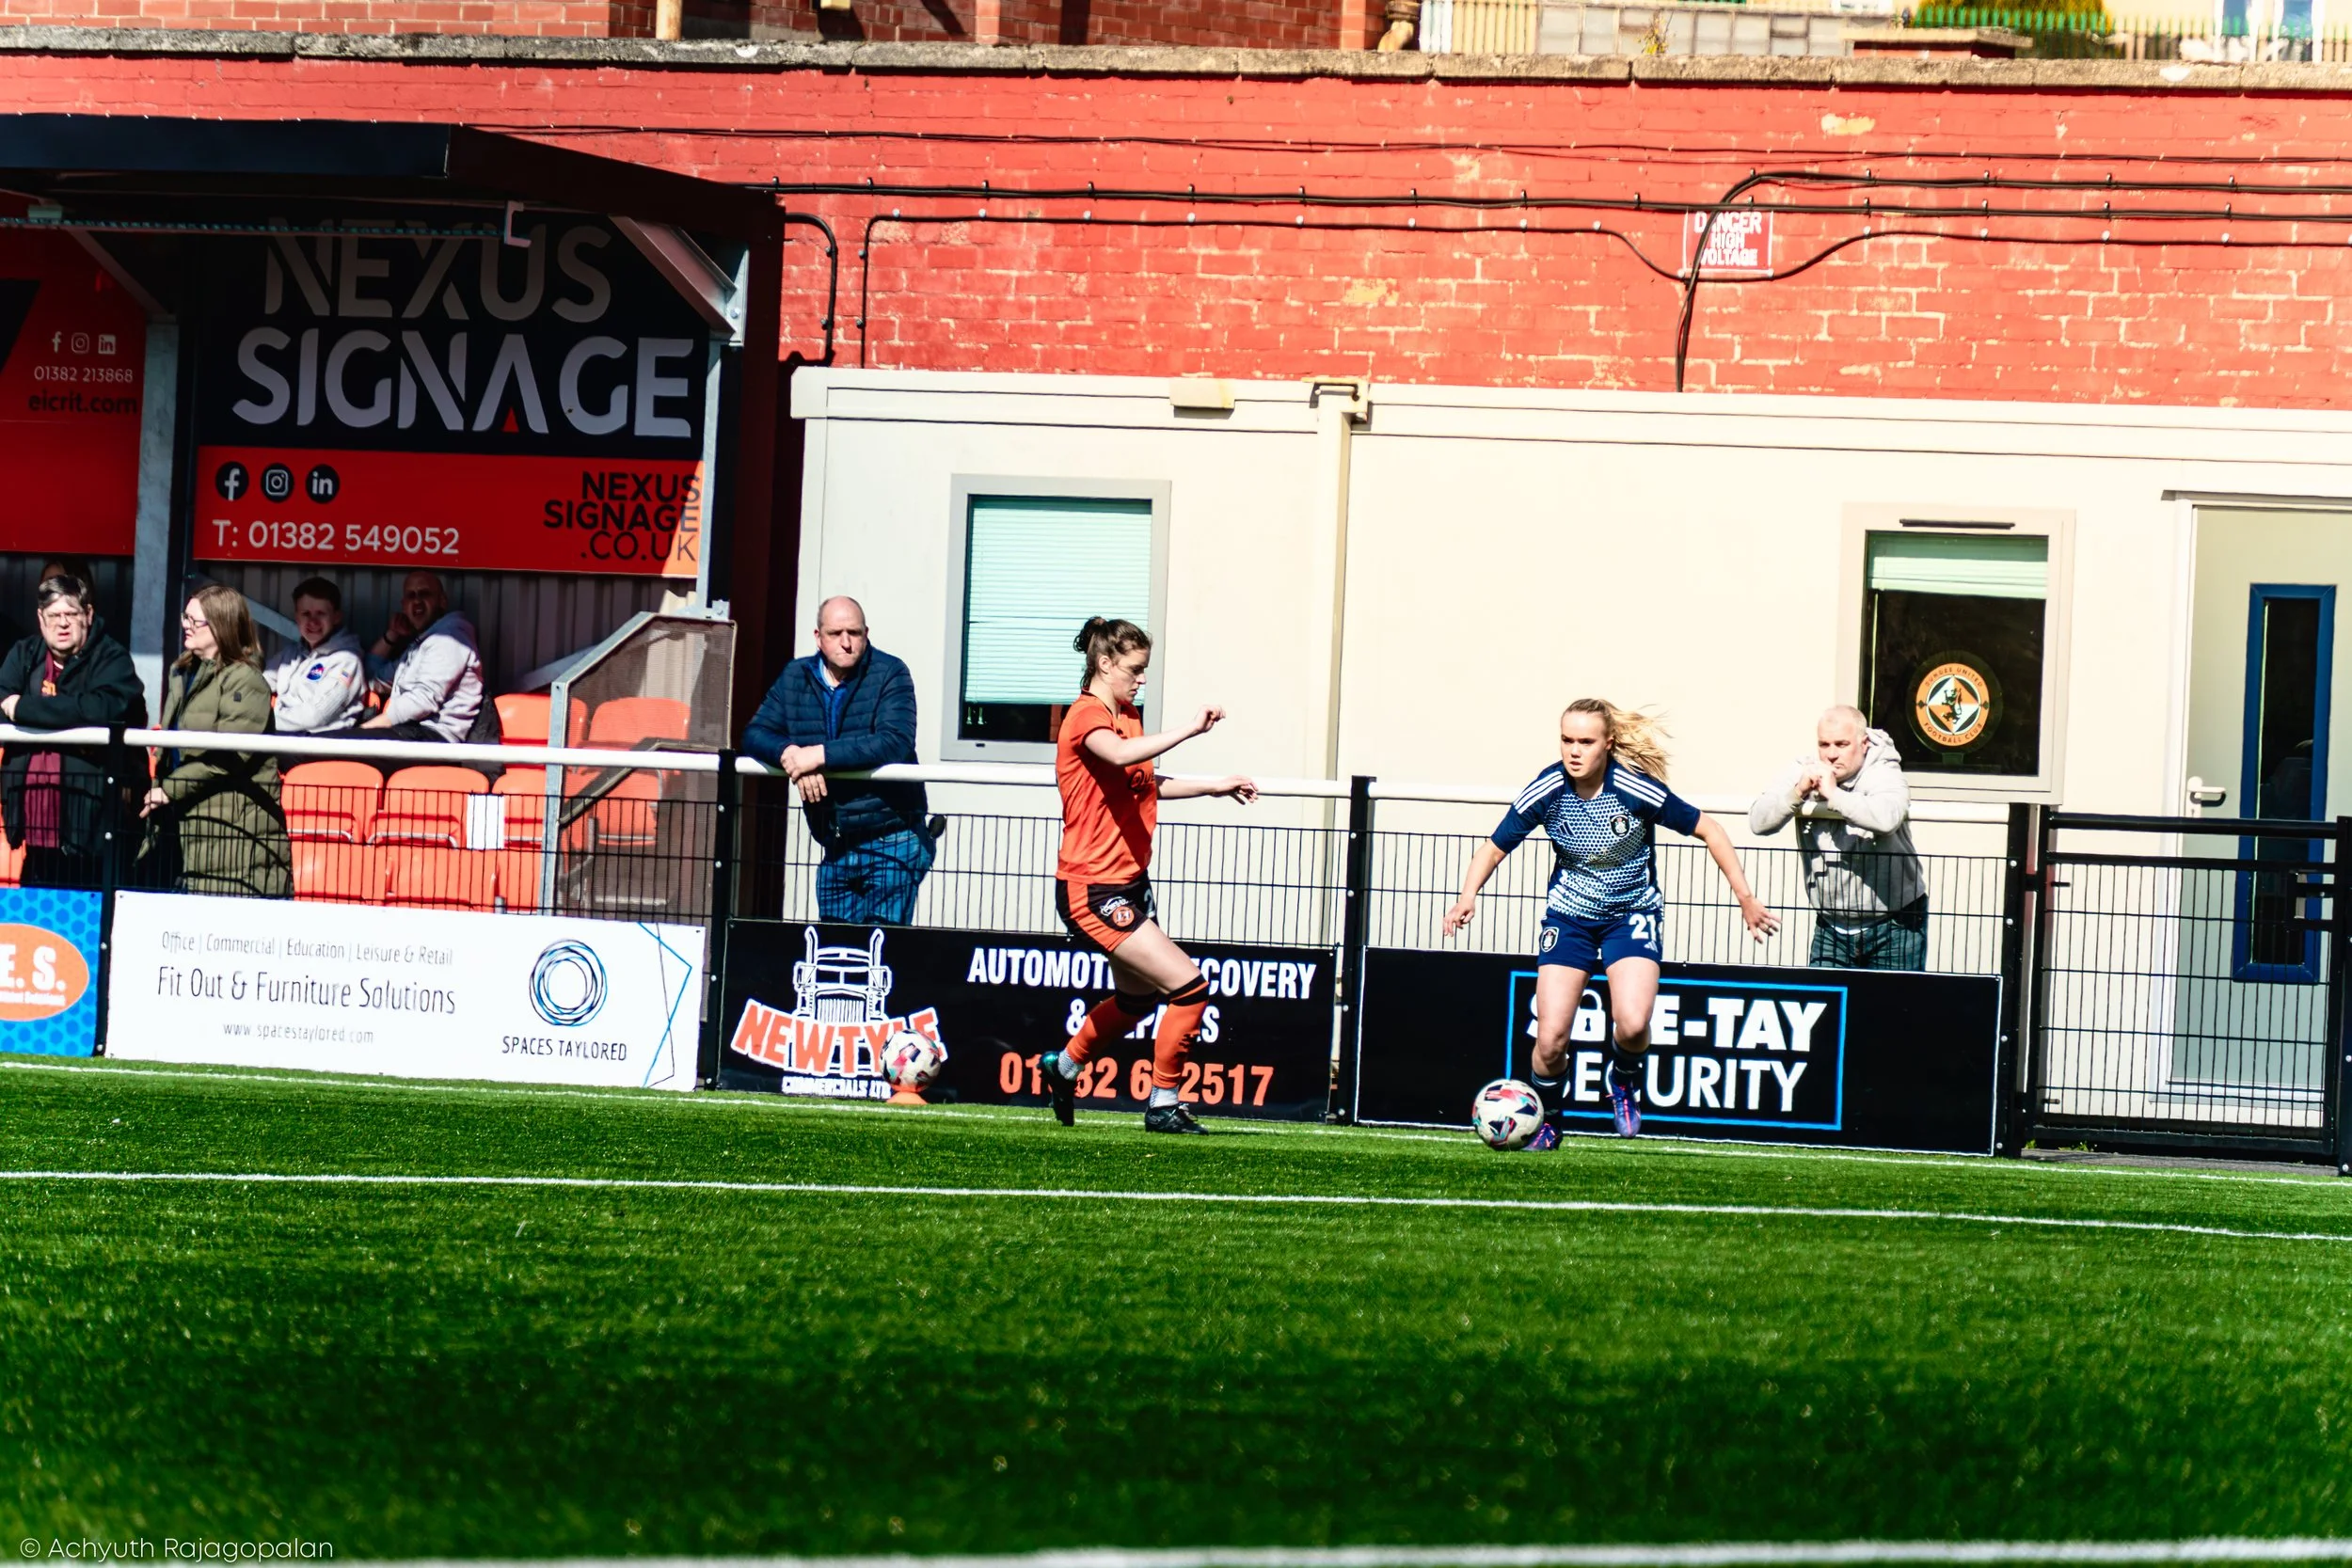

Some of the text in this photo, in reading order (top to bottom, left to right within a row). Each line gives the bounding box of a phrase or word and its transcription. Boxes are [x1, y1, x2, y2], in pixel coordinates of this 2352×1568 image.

[1710, 232, 1745, 249] HIGH
[264, 216, 612, 323] NEXUS
[34, 365, 134, 384] 01382 213868
[231, 326, 694, 437] SIGNAGE
[28, 389, 137, 414] eicrit.com
[581, 471, 700, 503] NEXUS
[543, 499, 699, 532] SIGNAGE
[212, 519, 459, 555] T: 01382 549052
[580, 531, 696, 562] .CO.UK
[1957, 667, 1983, 688] UNITED
[1924, 721, 1962, 744] FOOTBALL
[1629, 913, 1657, 941] 21
[162, 931, 453, 965] Office Commercial Education Leisure & Retail
[966, 947, 1317, 1000] AUTOMOTI COVERY
[158, 966, 455, 1015] Fit Out & Furniture Solutions
[1066, 998, 1088, 1037] &
[502, 1036, 628, 1061] SPACES TAYLORED
[731, 999, 947, 1076] NEWTYE
[999, 1052, 1275, 1107] 0182 62517
[1562, 1051, 1807, 1113] EURITY
